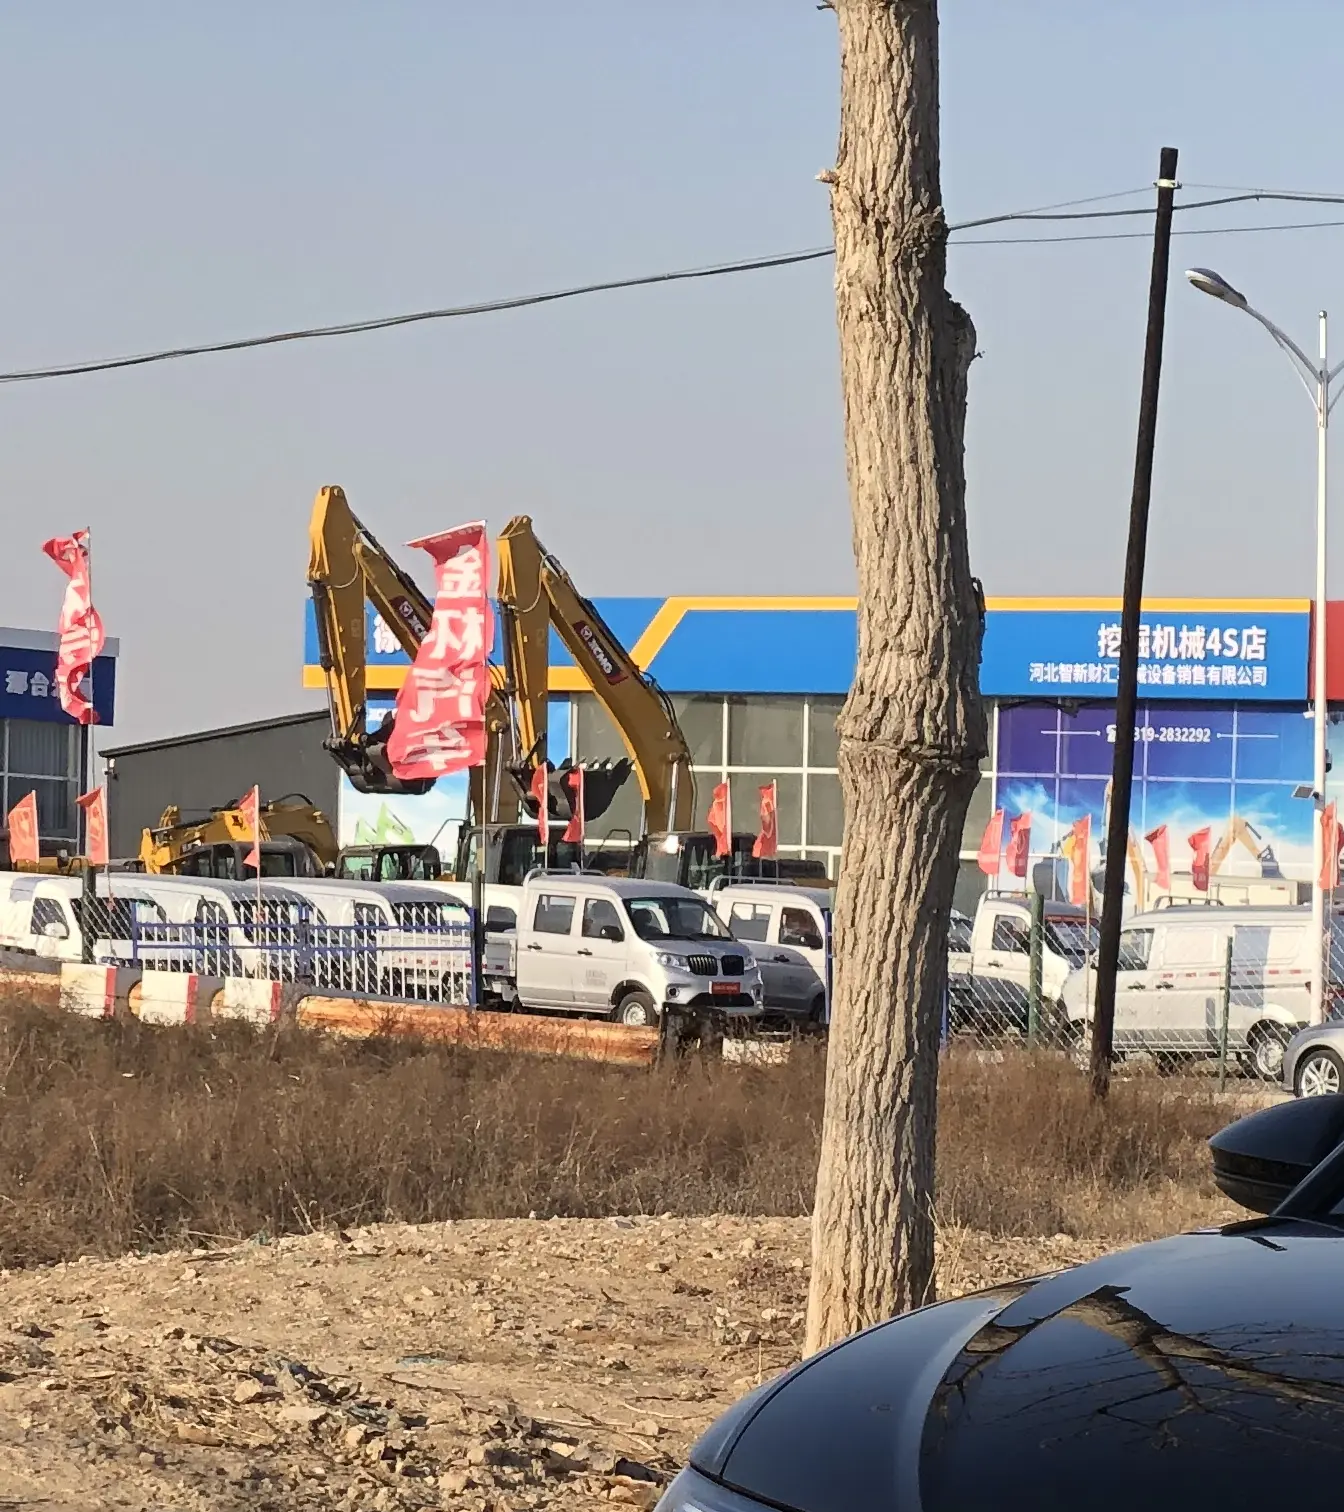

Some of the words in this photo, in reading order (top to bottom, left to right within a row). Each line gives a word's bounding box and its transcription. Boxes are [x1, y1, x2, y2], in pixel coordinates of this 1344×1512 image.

[1029, 663, 1267, 687] 河北智新财汇械设备销售有限公司
[1133, 725, 1211, 743] 319-2832292
